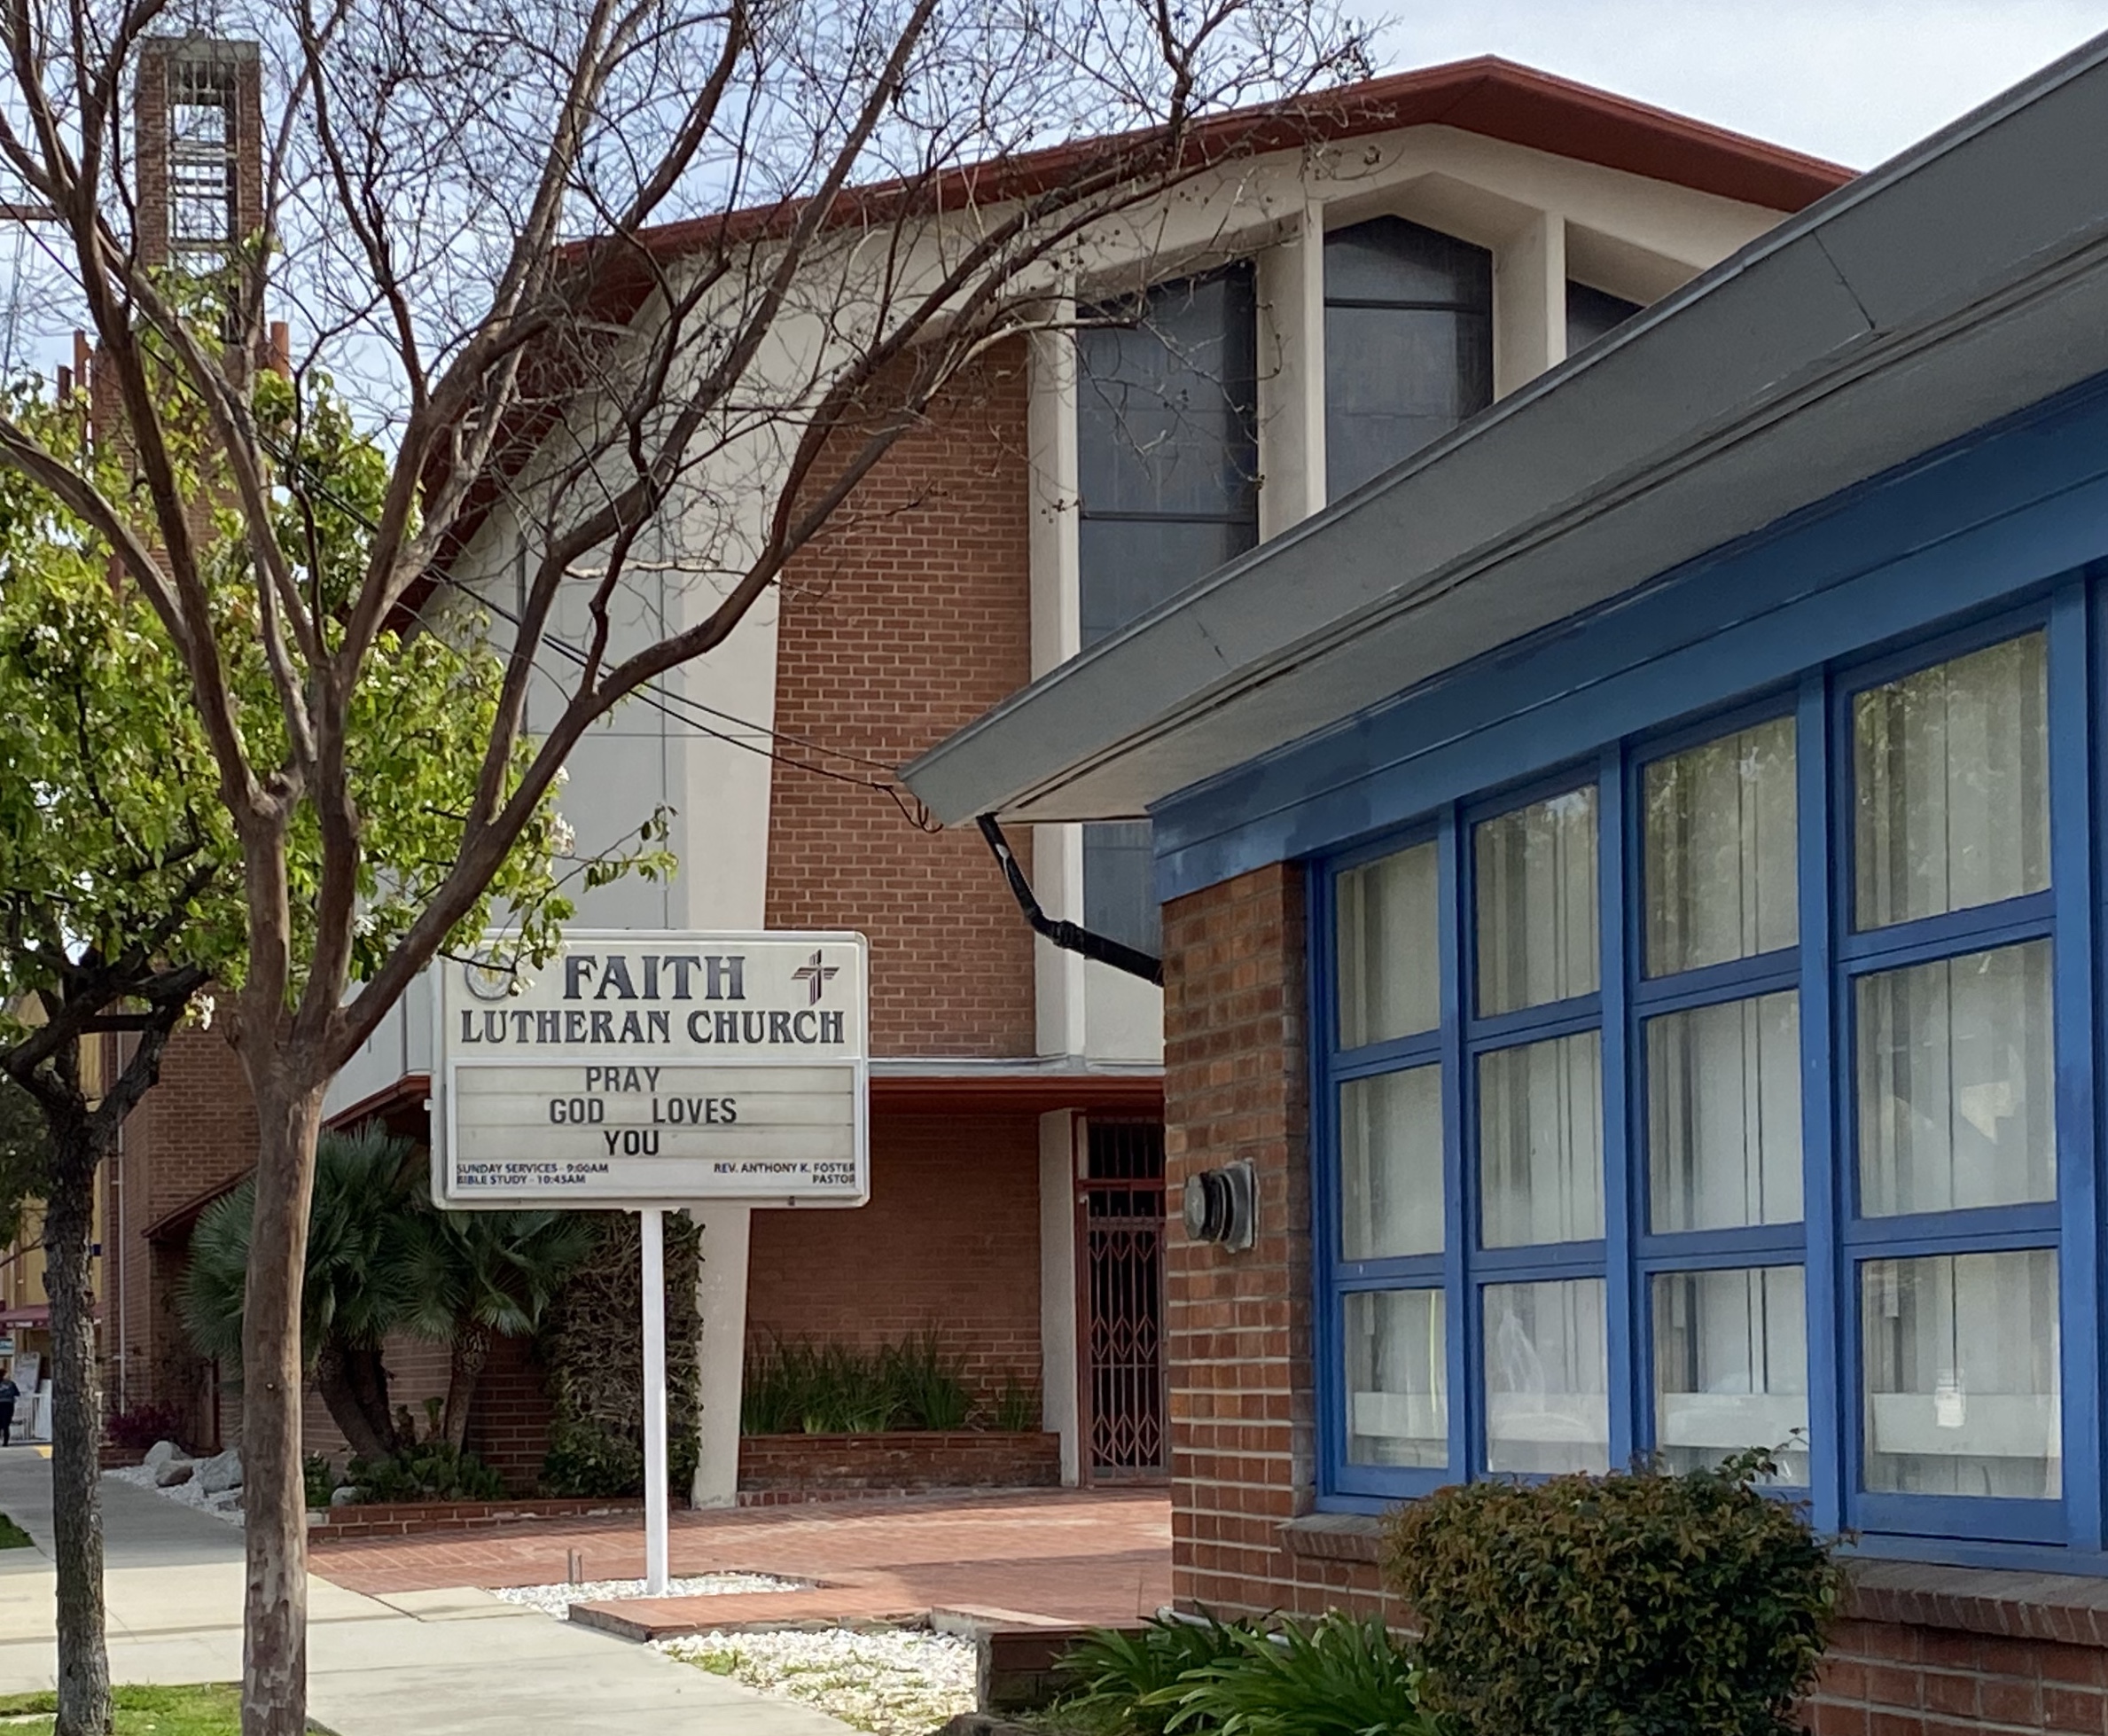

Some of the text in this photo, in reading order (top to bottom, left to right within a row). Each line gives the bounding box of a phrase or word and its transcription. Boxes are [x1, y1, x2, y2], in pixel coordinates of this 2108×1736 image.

[563, 955, 746, 1000] FAITH
[461, 1010, 846, 1044] LUTHERAN CHURCH
[586, 1066, 660, 1091] PRAY
[549, 1098, 738, 1124] GOD LOVES
[604, 1130, 660, 1155] YOU
[457, 1163, 503, 1174] SUNDAY
[505, 1163, 558, 1173] SERVICES
[566, 1163, 609, 1173] 9:00AM
[457, 1175, 487, 1185] BIBLE
[489, 1175, 527, 1185] STUDY
[537, 1175, 586, 1184] 10:45AM
[714, 1162, 855, 1173] REV. ANTHONY K. FOSTER
